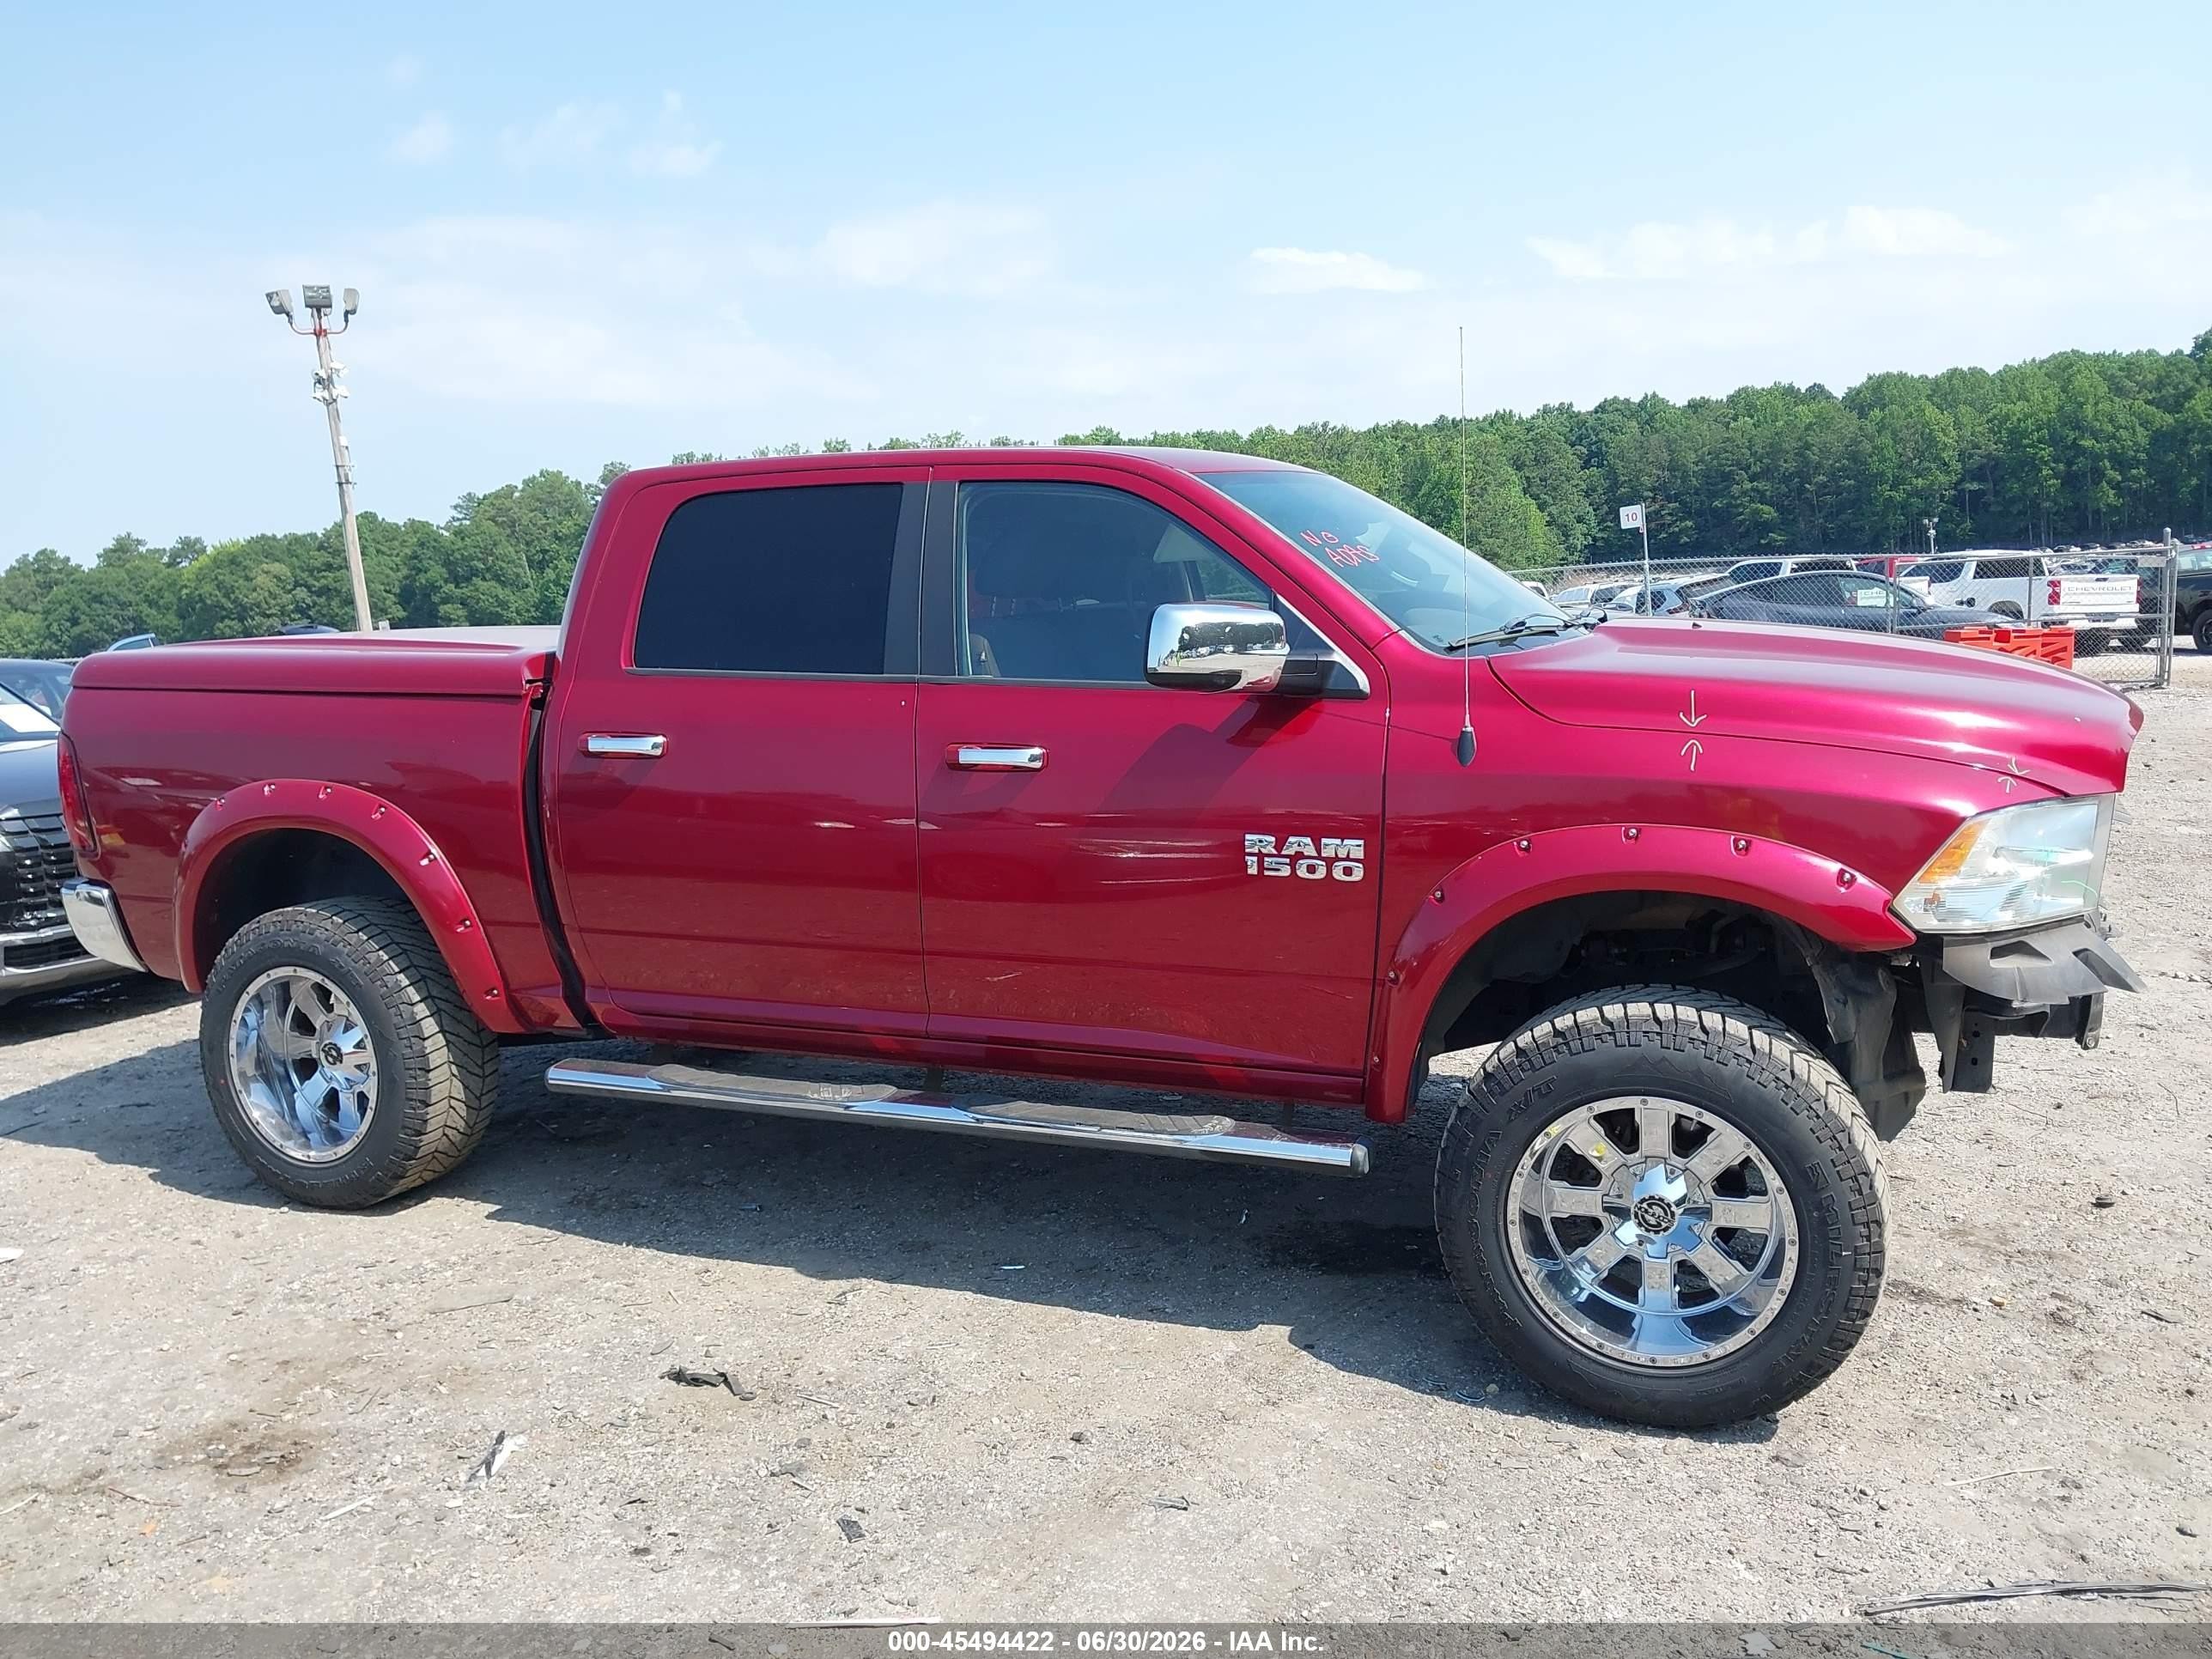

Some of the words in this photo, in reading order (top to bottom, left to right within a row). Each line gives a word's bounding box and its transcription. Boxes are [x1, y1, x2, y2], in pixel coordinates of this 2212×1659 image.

[1625, 512, 1638, 523] 10
[1244, 833, 1365, 860] RAM
[1244, 855, 1365, 882] 1500
